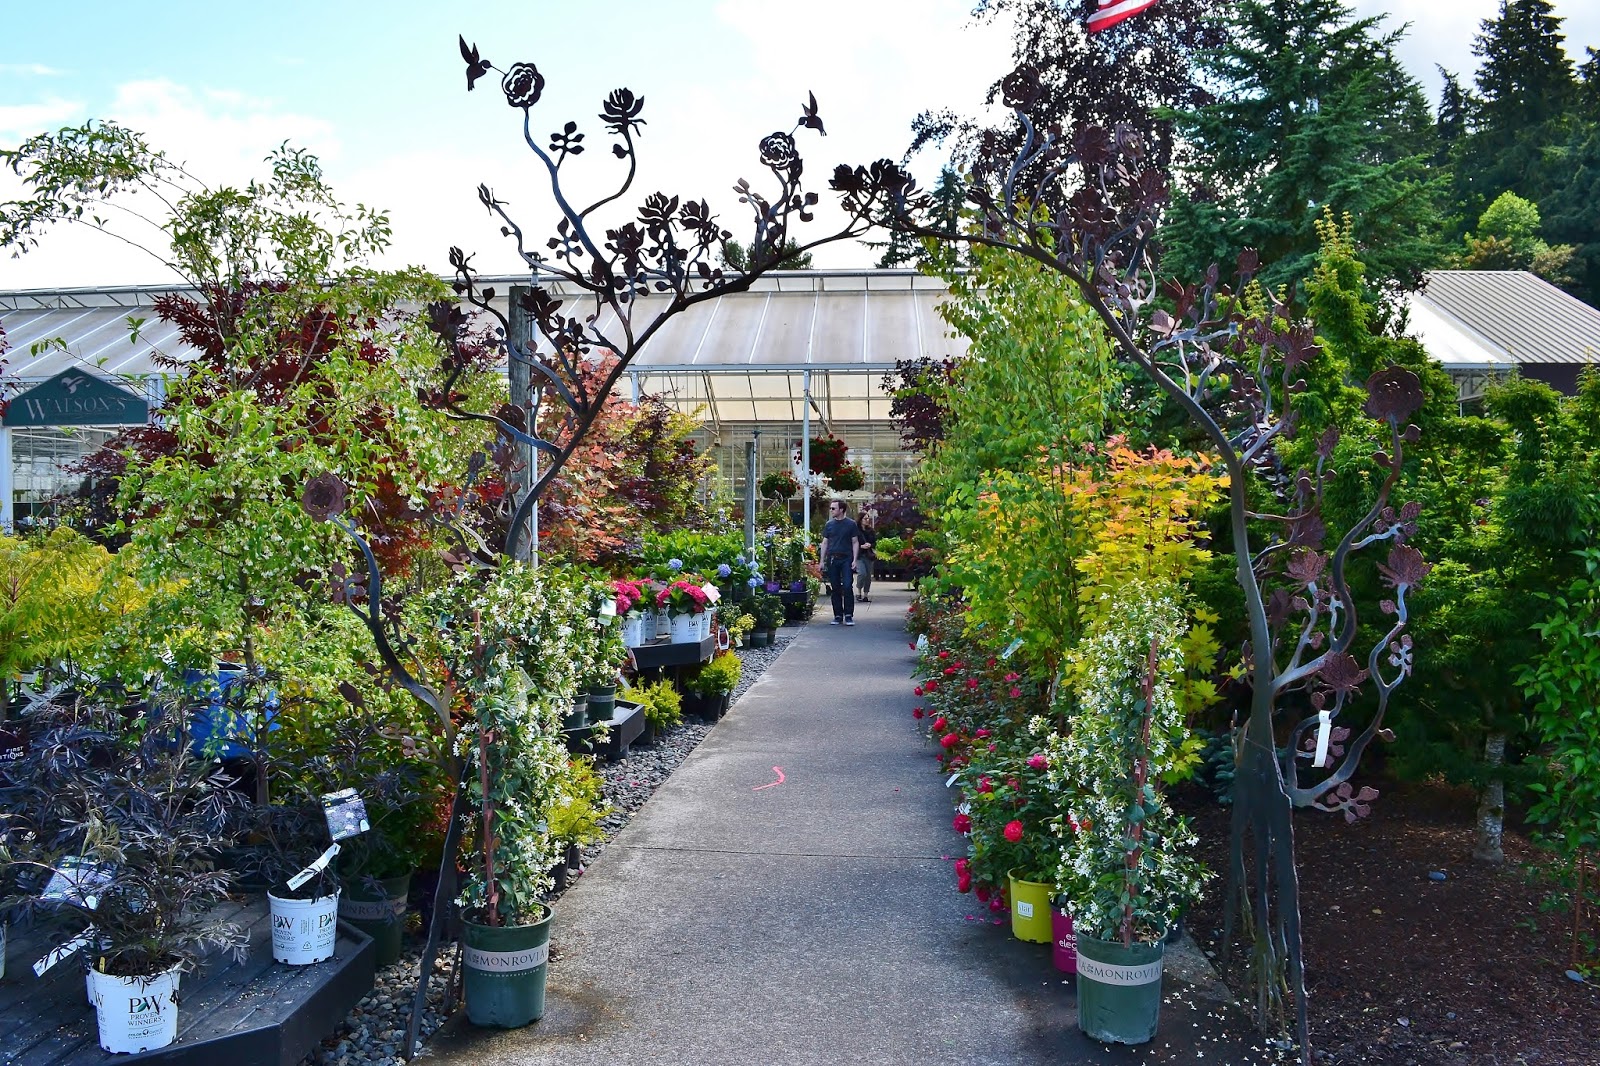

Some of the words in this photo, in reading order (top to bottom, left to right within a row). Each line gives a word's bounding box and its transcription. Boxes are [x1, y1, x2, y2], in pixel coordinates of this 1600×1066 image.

[0, 752, 24, 760] TIONS
[273, 914, 294, 930] PW
[479, 950, 544, 967] MONROVIA
[1094, 966, 1159, 981] MONROVIA
[128, 993, 163, 1015] PW
[128, 1016, 162, 1026] WINNERS
